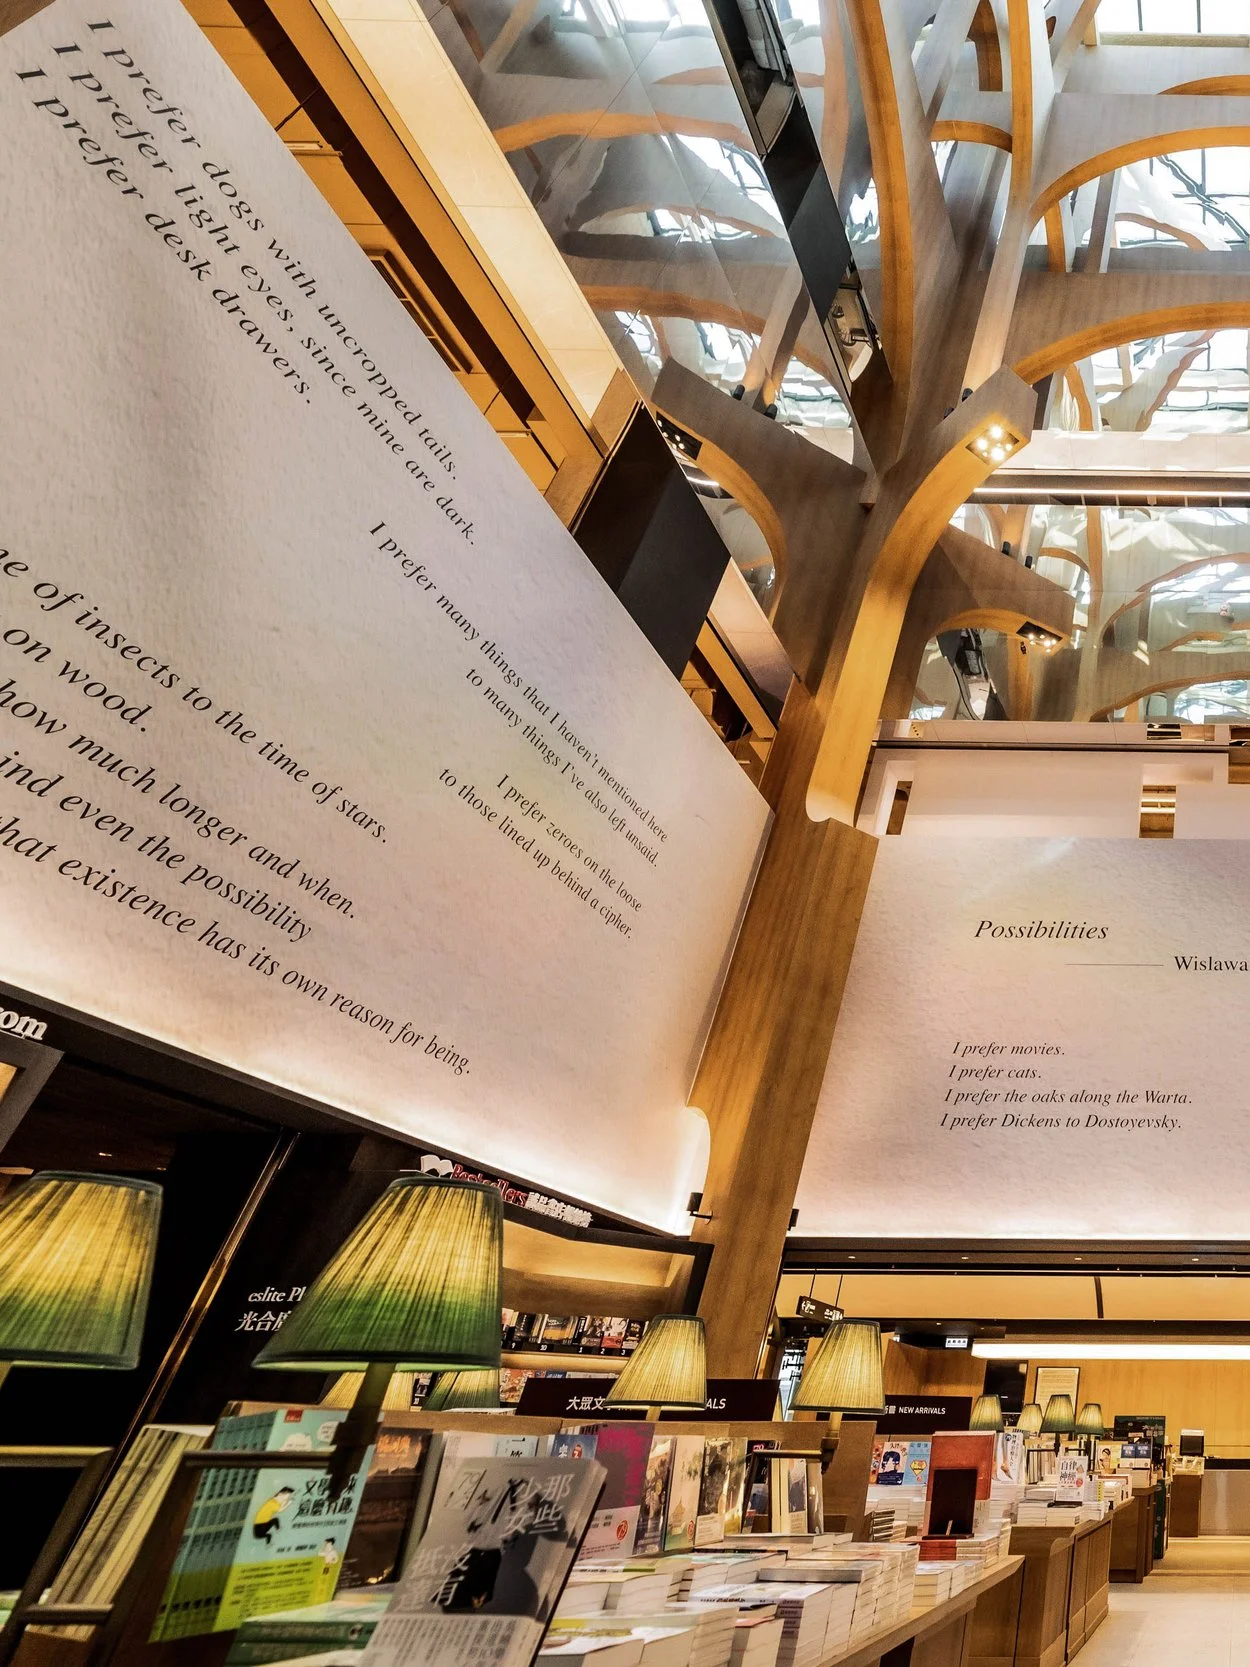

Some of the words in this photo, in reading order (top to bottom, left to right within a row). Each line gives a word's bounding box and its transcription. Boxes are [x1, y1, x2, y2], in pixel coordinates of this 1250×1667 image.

[14, 66, 49, 83] I
[31, 95, 145, 200] prefer
[86, 18, 116, 34] I
[101, 47, 202, 149] prefer
[201, 161, 265, 232] dogs
[267, 237, 317, 299] with
[317, 303, 423, 426] uncropped
[418, 427, 456, 481] tails.
[144, 213, 212, 282] desk
[211, 288, 311, 405] drawers.
[369, 520, 387, 537] I
[377, 536, 437, 592] prefer
[436, 593, 480, 642] many
[479, 640, 522, 688] things
[32, 582, 85, 612] of
[74, 606, 181, 689] insects
[181, 686, 213, 712] to
[214, 710, 257, 744] the
[257, 741, 310, 783] time
[311, 781, 344, 805] of
[335, 799, 386, 844] stars.
[522, 686, 551, 717] that
[549, 711, 561, 725] I
[598, 766, 650, 821] mentioned
[496, 773, 510, 790] I
[503, 785, 547, 823] prefer
[545, 821, 584, 859] zeroes
[583, 856, 599, 874] on
[598, 868, 617, 889] the
[615, 881, 642, 912] loose
[647, 816, 668, 843] here
[58, 795, 135, 843] even
[136, 835, 186, 870] the
[179, 863, 312, 943] possibility
[0, 816, 59, 864] hat
[57, 859, 196, 934] existence
[197, 919, 248, 960] has
[247, 946, 281, 977] its
[281, 970, 329, 1002] own
[329, 992, 395, 1035] reason
[388, 1021, 425, 1048] for
[423, 1034, 470, 1076] being.
[973, 920, 1109, 940] Possibilities
[1174, 956, 1249, 972] Wislawa
[952, 1041, 961, 1054] I
[961, 1042, 1007, 1058] prefer
[1010, 1042, 1066, 1056] movies.
[948, 1064, 957, 1079] I
[957, 1065, 1004, 1082] prefer
[1007, 1066, 1042, 1079] cats.
[940, 1113, 949, 1127] I
[949, 1113, 998, 1131] prefer
[1001, 1113, 1062, 1128] Dickens
[1066, 1116, 1081, 1128] to
[1085, 1114, 1182, 1132] Dostoyevsky.
[248, 1286, 286, 1302] eslite
[898, 1406, 914, 1414] NEW
[914, 1407, 946, 1415] ARRIVALS
